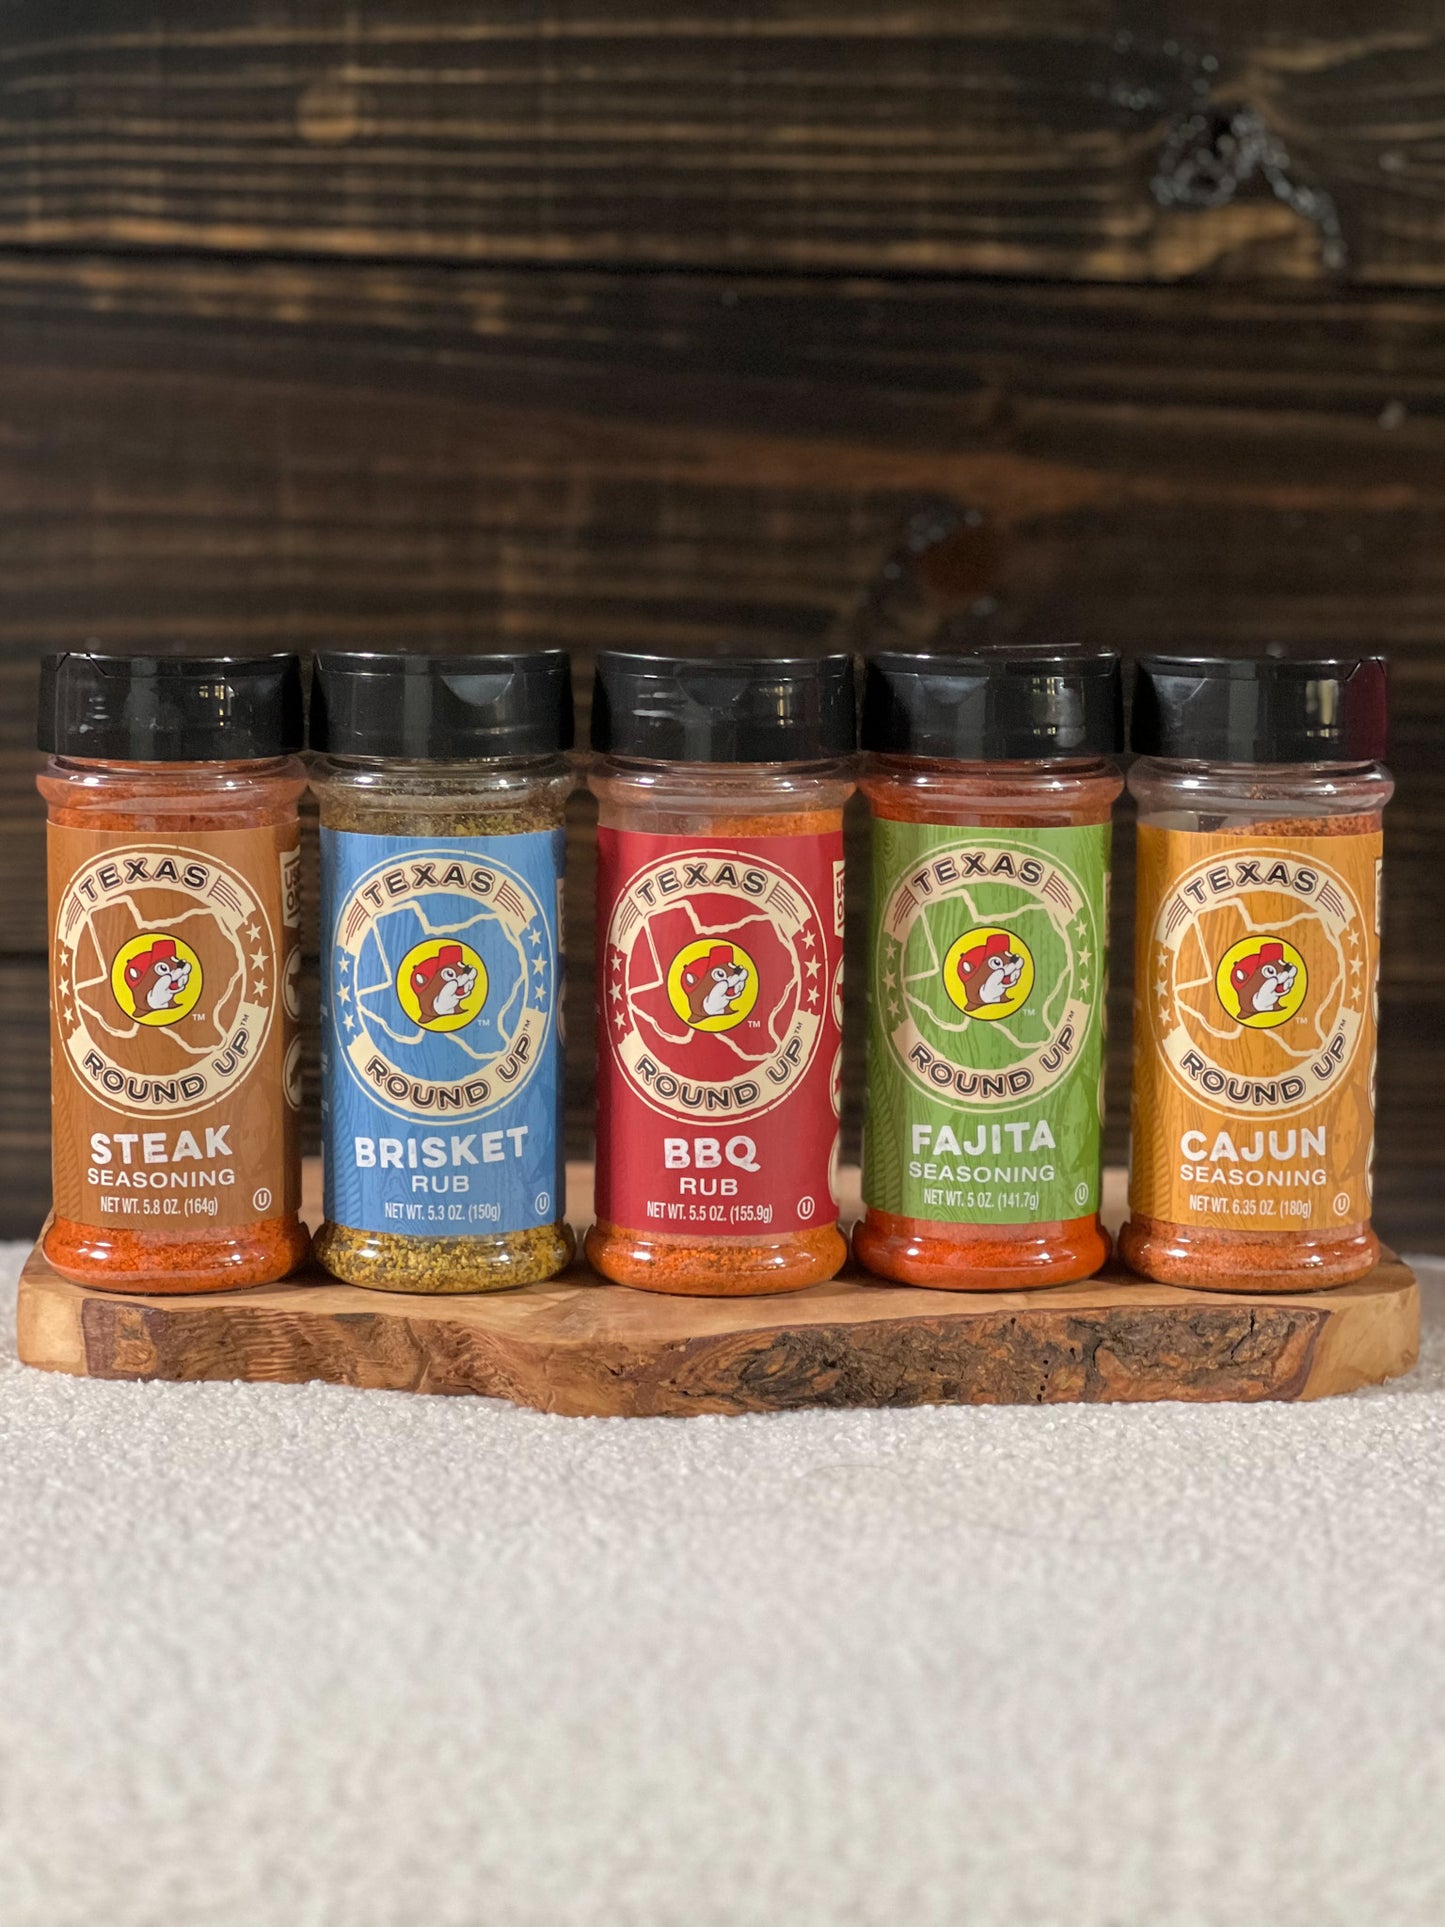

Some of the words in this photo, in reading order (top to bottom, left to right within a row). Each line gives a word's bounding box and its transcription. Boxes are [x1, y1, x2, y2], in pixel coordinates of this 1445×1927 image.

[79, 858, 210, 901] TEXAS
[363, 864, 496, 907] TEXAS
[636, 864, 768, 906] TEXAS
[913, 852, 1044, 894] TEXAS
[1185, 861, 1318, 904] TEXAS
[84, 1049, 206, 1103] ROUND
[366, 1055, 490, 1109] ROUND
[636, 1055, 760, 1109] ROUND
[910, 1041, 1034, 1097] ROUND
[1180, 1050, 1305, 1105] ROUND
[90, 1124, 233, 1164] STEAK
[355, 1126, 529, 1169] BRISKET
[664, 1135, 761, 1172] BBQ
[912, 1119, 1056, 1156] FAJITA
[1180, 1126, 1326, 1162] CAJUN
[88, 1167, 235, 1188] SEASONING
[412, 1174, 470, 1193] RUB
[680, 1177, 738, 1196] RUB
[909, 1161, 1055, 1182] SEASONING
[1180, 1165, 1327, 1186] SEASONING
[100, 1197, 120, 1213] NET
[121, 1197, 140, 1213] WT.
[143, 1198, 162, 1214] 5.8
[164, 1198, 181, 1214] OZ.
[184, 1197, 218, 1216] (164g)
[385, 1202, 404, 1219] NET
[406, 1203, 425, 1220] WT.
[428, 1203, 445, 1220] 5.3
[447, 1203, 465, 1220] OZ.
[468, 1202, 501, 1222] (150g)
[647, 1201, 665, 1218] NET
[667, 1202, 686, 1219] WT.
[690, 1204, 706, 1221] 5.5
[708, 1204, 726, 1221] OZ.
[730, 1203, 773, 1223] (155.9g)
[924, 1191, 943, 1206] NET
[945, 1192, 965, 1206] WT.
[968, 1192, 974, 1207] 5
[978, 1192, 995, 1208] OZ.
[998, 1191, 1039, 1210] (141.7g)
[1189, 1194, 1209, 1211] NET
[1210, 1195, 1230, 1212] WT.
[1233, 1197, 1257, 1214] 6.35
[1260, 1197, 1277, 1215] OZ.
[1280, 1197, 1312, 1218] (180g)
